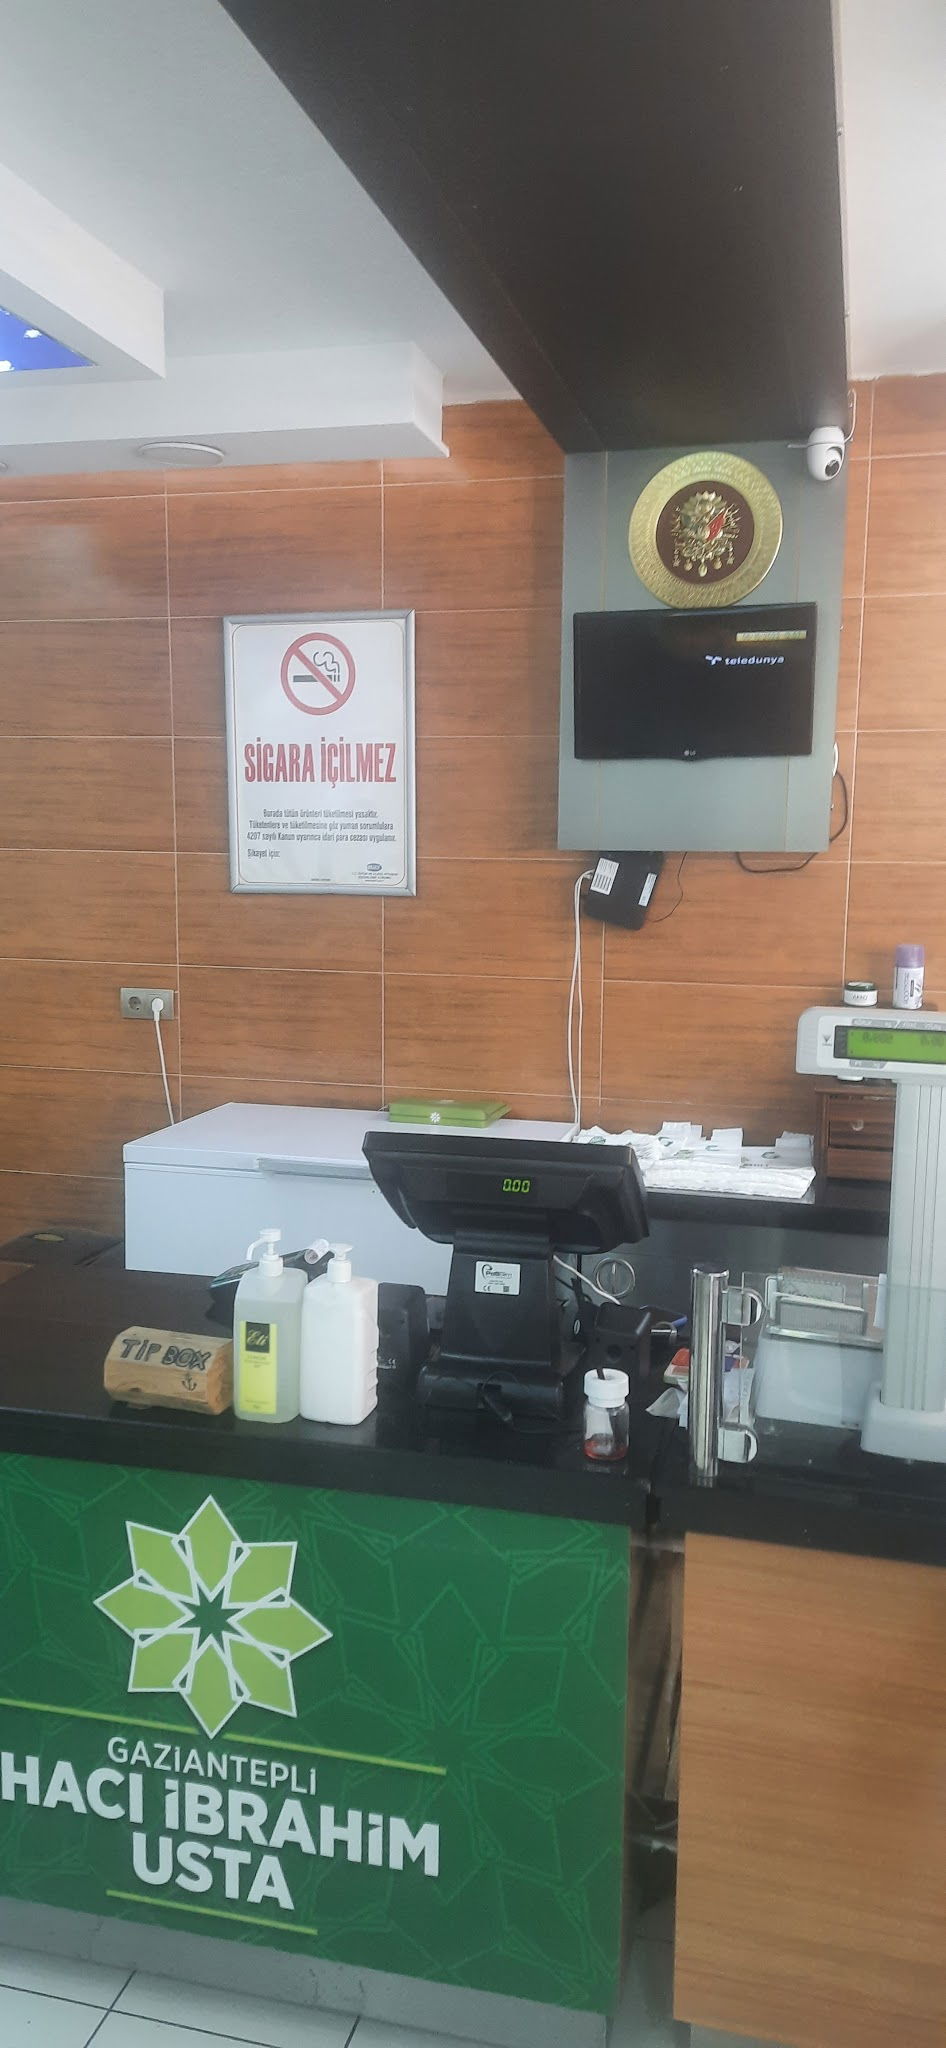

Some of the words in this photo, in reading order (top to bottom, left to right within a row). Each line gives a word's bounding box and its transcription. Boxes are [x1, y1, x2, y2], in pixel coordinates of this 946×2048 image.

[724, 655, 785, 665] teledunya
[244, 736, 315, 782] SİGARA
[320, 736, 397, 789] İÇİLMEZ
[263, 808, 283, 818] Burada
[246, 831, 261, 841] 4207
[503, 1178, 531, 1193] 0.00
[161, 1345, 211, 1371] BOX
[0, 1751, 144, 1824] HACI
[131, 1831, 295, 1910] USTA
